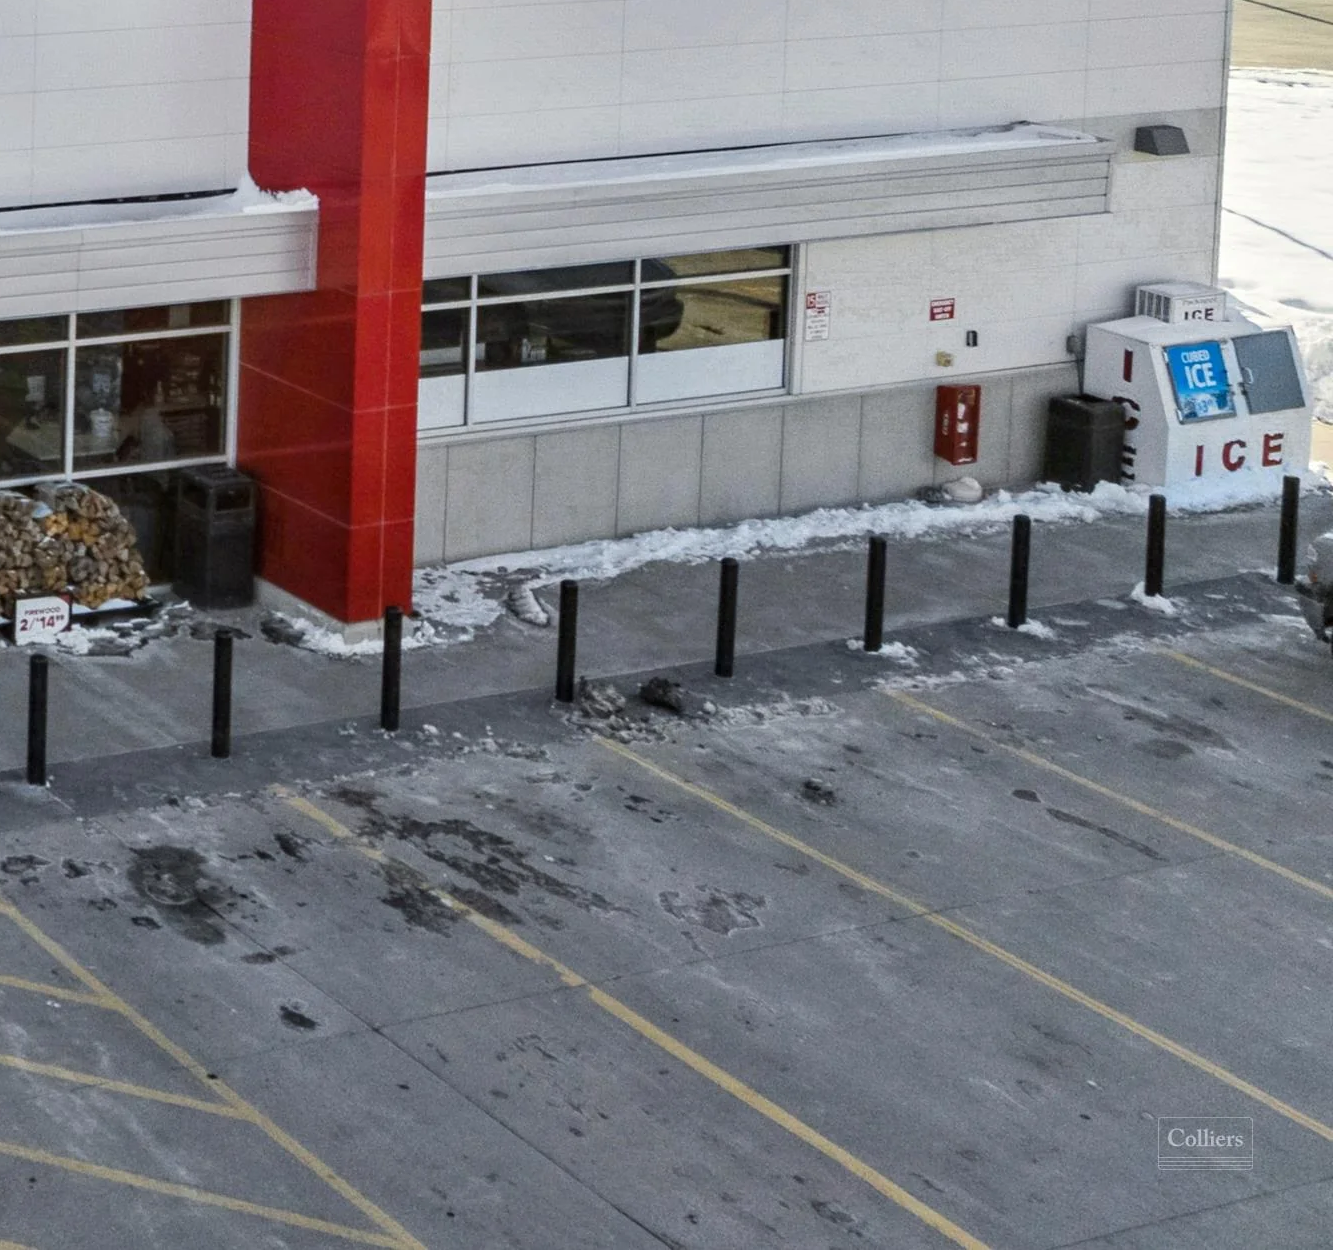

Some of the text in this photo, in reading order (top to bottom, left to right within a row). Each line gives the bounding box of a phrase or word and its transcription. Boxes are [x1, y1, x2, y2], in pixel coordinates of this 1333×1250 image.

[1184, 308, 1214, 321] ICE
[1184, 362, 1217, 390] ICE
[1194, 432, 1284, 477] ICE
